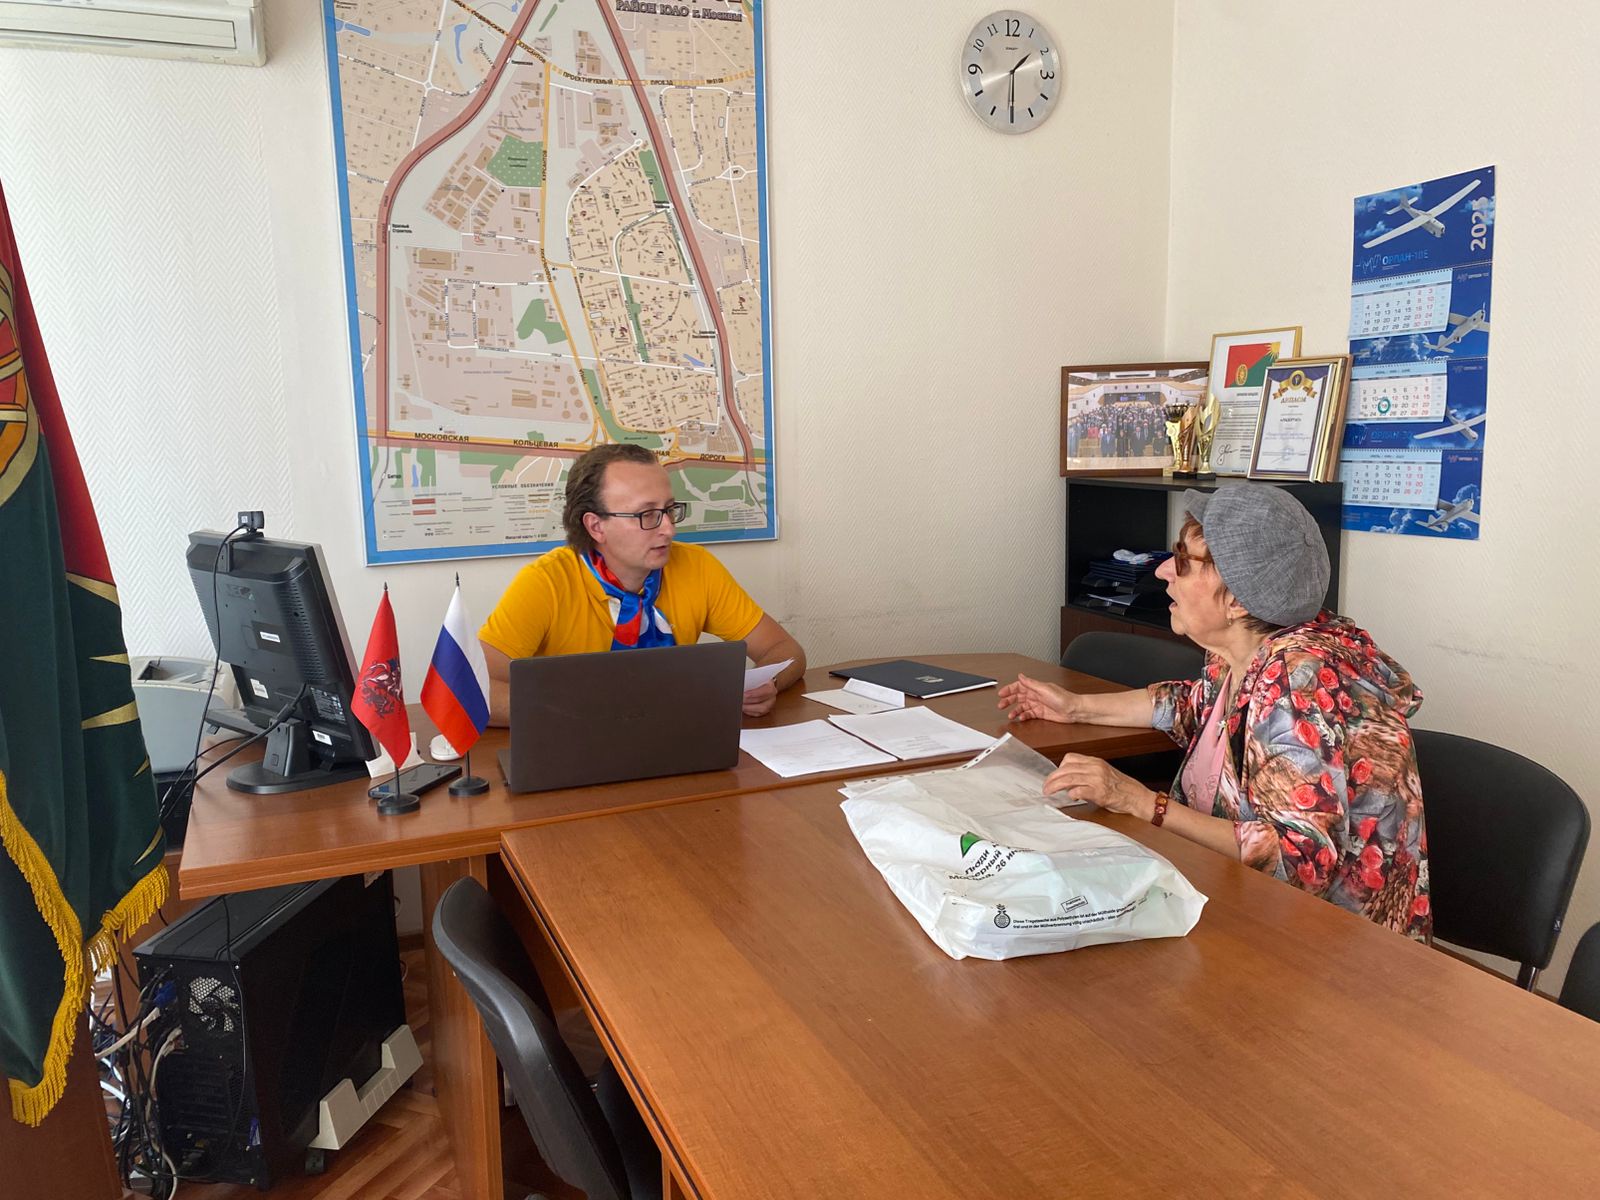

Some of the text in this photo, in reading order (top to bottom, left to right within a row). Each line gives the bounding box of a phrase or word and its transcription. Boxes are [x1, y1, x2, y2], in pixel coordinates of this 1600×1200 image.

[616, 0, 657, 14] РАЙОН
[660, 4, 689, 17] ЮАО
[702, 8, 742, 22] Москвы
[987, 23, 998, 37] 11
[1005, 19, 1020, 37] 12
[1028, 28, 1034, 38] 1
[973, 38, 984, 52] 10
[1040, 47, 1049, 55] 2
[968, 64, 984, 75] 9
[1040, 69, 1055, 80] 3
[562, 71, 614, 85] ПРОЕКТИРУЕМЫЙ
[414, 432, 469, 442] МОСКОВСКАЯ
[513, 439, 559, 448] КОЛЬЦЕВАЯ
[700, 453, 726, 461] ДОРОГА
[965, 850, 990, 875] Люди
[969, 849, 1002, 878] ерный
[995, 859, 1007, 872] 26
